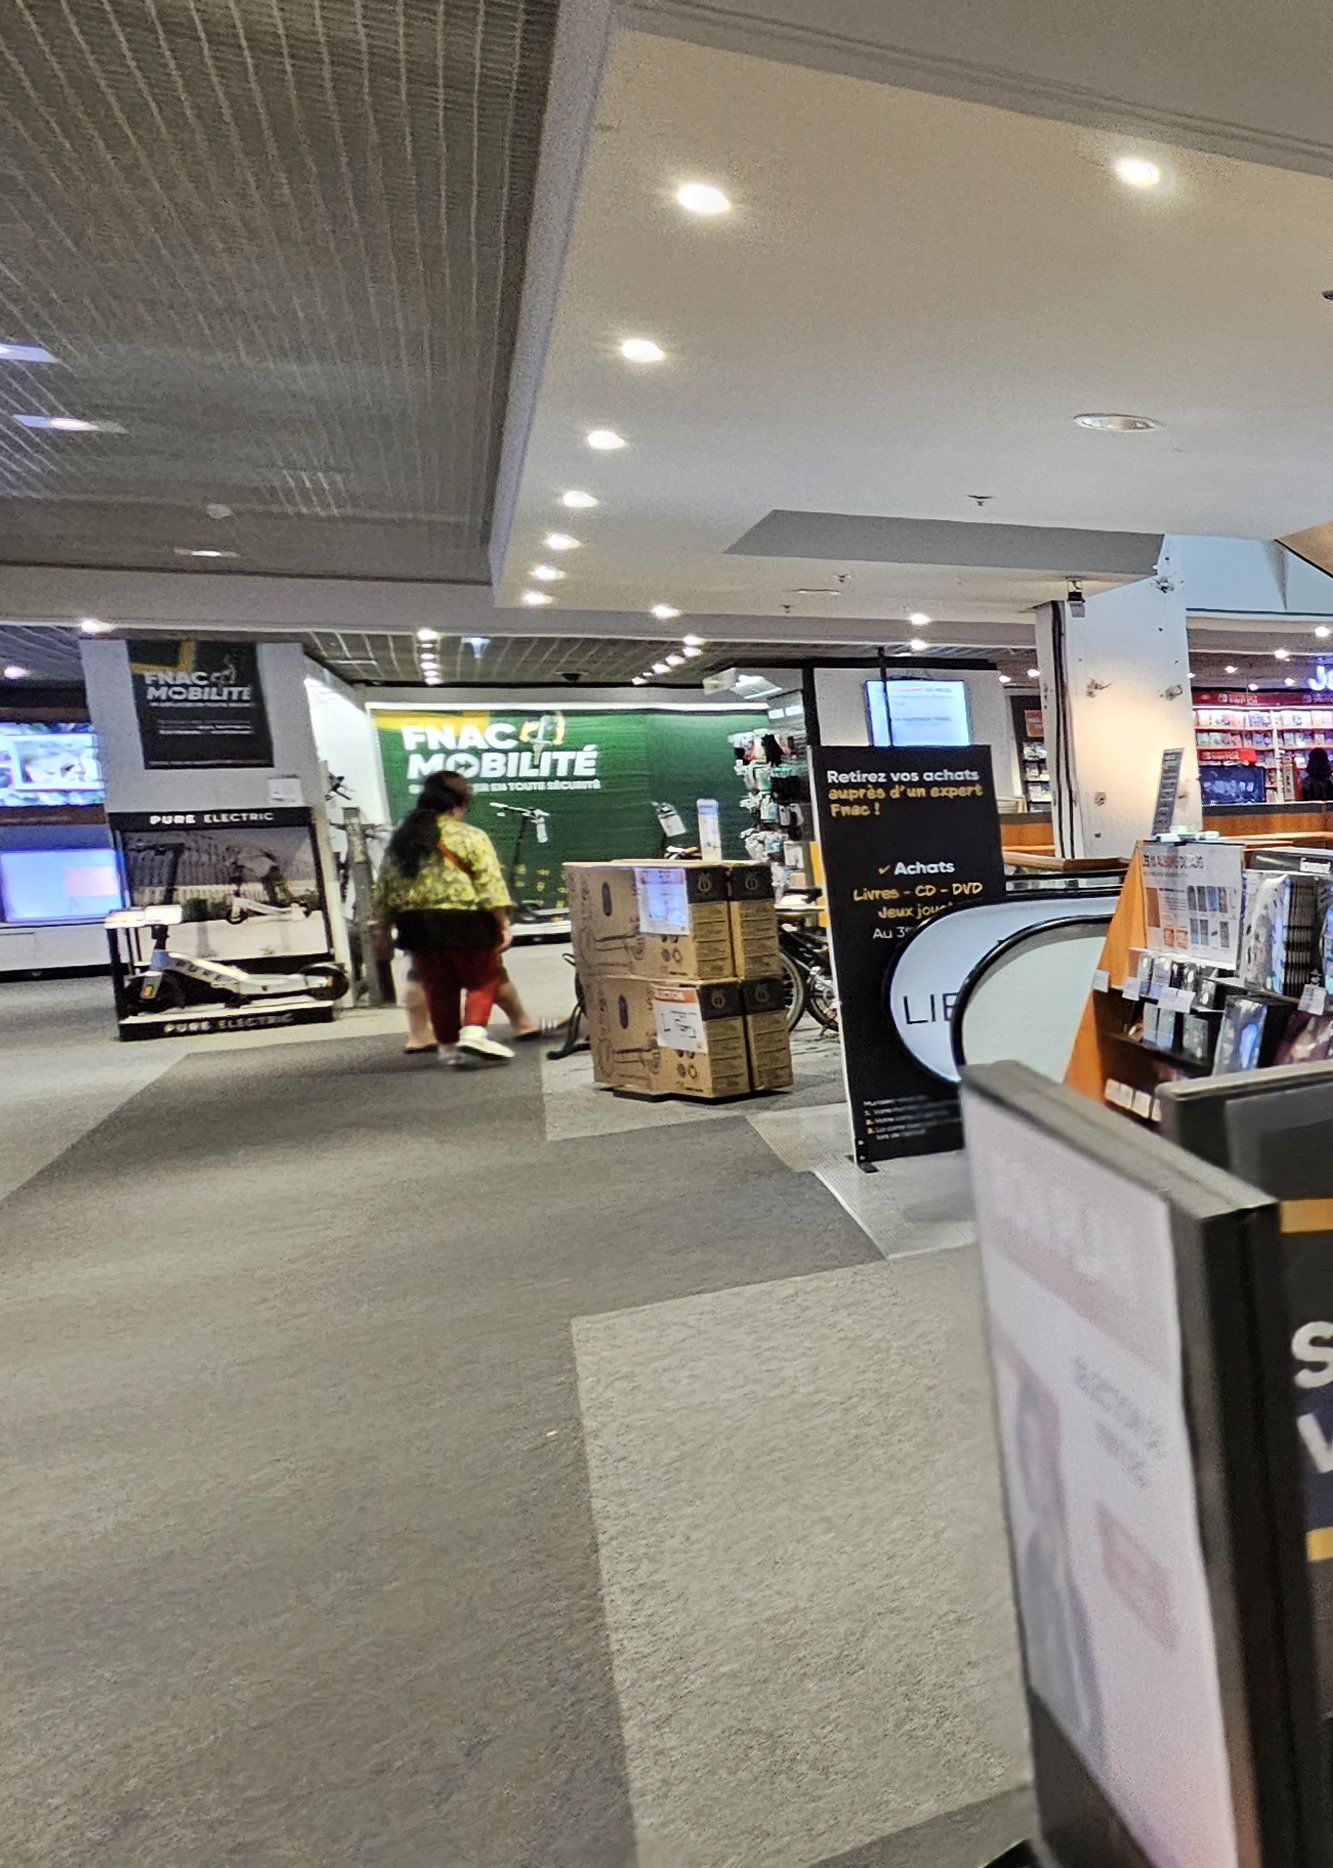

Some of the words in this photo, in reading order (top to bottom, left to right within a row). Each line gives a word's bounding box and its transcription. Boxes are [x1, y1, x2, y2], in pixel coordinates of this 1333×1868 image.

[144, 671, 208, 685] FNAC
[401, 723, 519, 750] FNAC
[406, 744, 598, 779] MOBILITÉ
[827, 770, 887, 783] Retirez
[890, 771, 919, 782] vos
[922, 769, 980, 782] achats
[491, 783, 507, 792] EN
[509, 781, 546, 791] TOUTE
[547, 779, 601, 790] SÉCURITÉ
[828, 785, 886, 801] auprès
[930, 784, 983, 801] expert
[830, 803, 871, 817] Fnac
[875, 802, 880, 815] !
[150, 814, 196, 825] PURE
[204, 812, 275, 823] ELECTRIC
[894, 862, 956, 876] Achats
[853, 888, 900, 902] Livres
[915, 885, 936, 897] CD
[952, 882, 983, 895] DVD
[878, 905, 912, 919] Jeux
[915, 902, 953, 919] jou
[873, 928, 892, 939] Au
[177, 960, 222, 983] PURE
[164, 1020, 212, 1033] PURE
[217, 1013, 294, 1029] ELECTRIC
